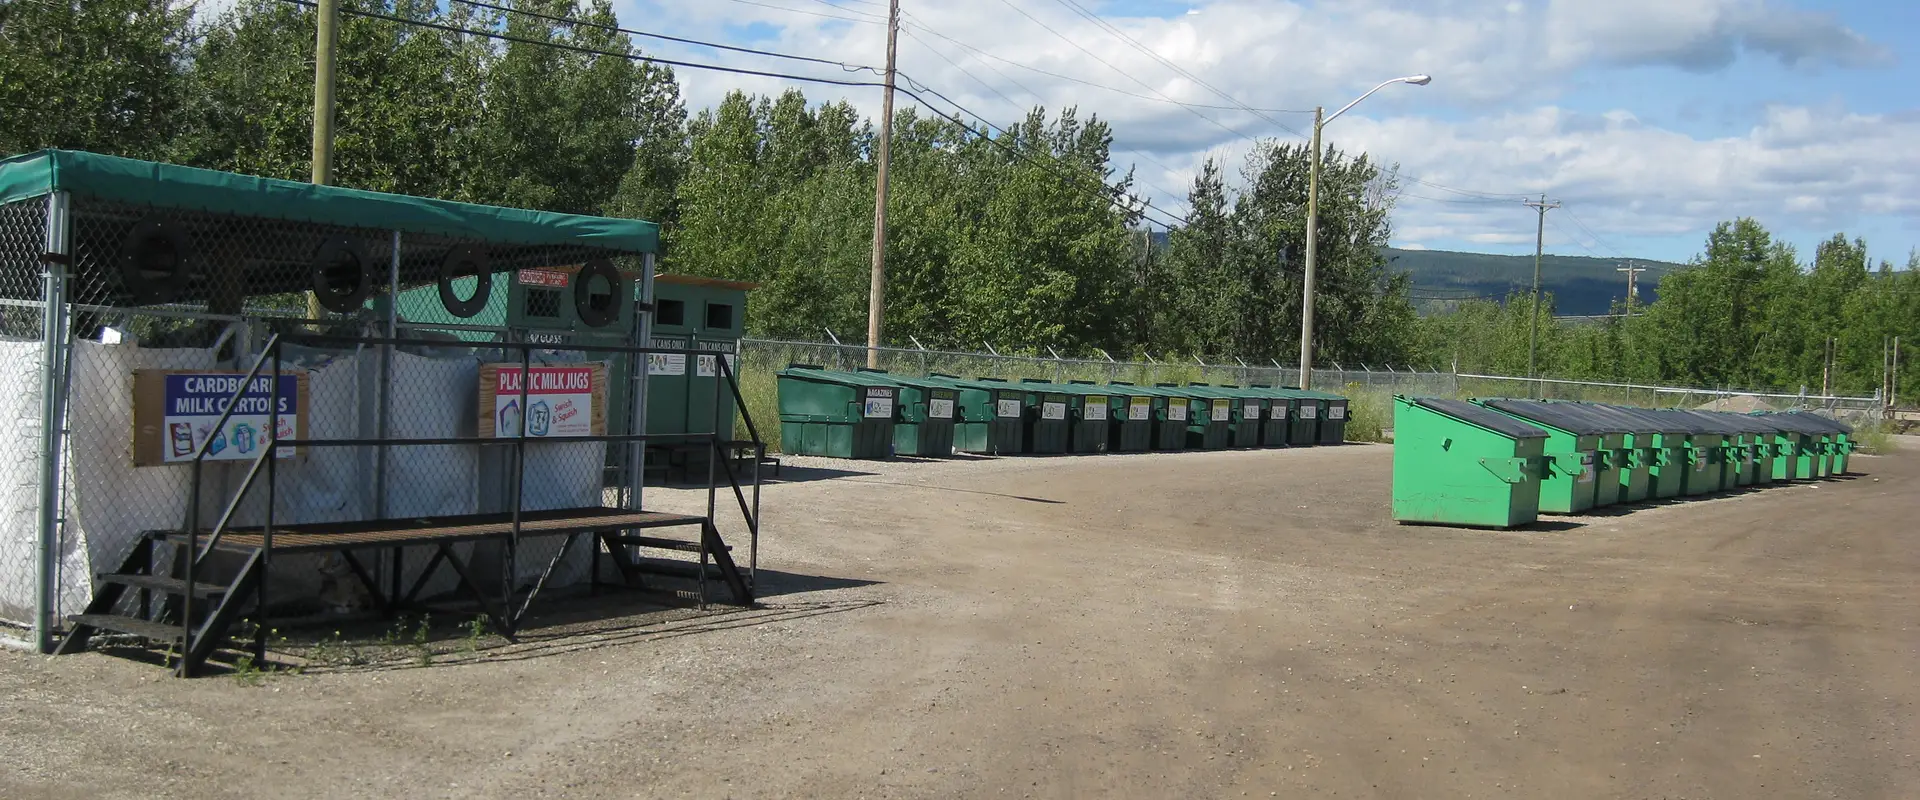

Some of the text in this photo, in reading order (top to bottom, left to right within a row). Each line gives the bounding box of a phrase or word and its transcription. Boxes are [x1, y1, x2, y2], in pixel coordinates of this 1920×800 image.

[657, 340, 671, 349] CANS
[672, 340, 686, 349] ONLY
[699, 342, 734, 352] TIN CANS ONLY
[185, 377, 274, 393] CARDBAR
[541, 372, 565, 390] MILK
[565, 372, 589, 389] JUGS
[176, 397, 215, 413] MILK
[554, 398, 573, 413] Swish
[552, 407, 578, 424] & Squish
[259, 435, 265, 444] &
